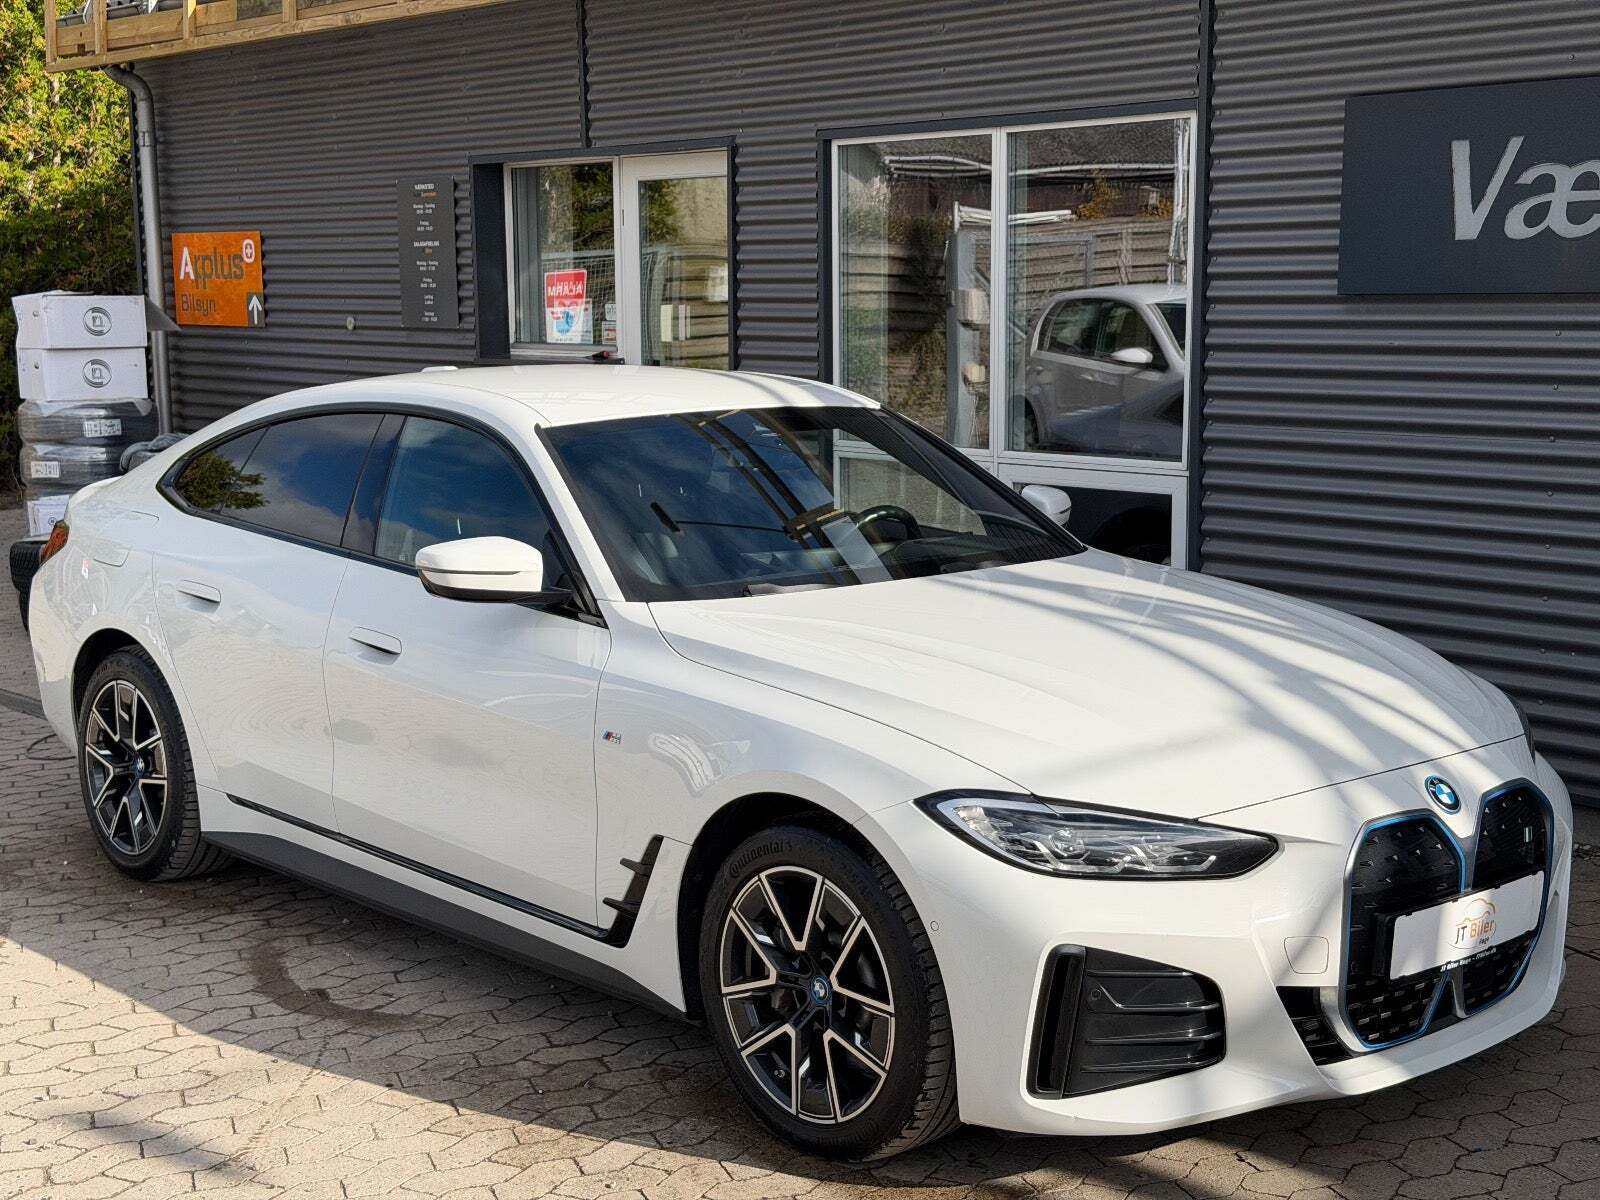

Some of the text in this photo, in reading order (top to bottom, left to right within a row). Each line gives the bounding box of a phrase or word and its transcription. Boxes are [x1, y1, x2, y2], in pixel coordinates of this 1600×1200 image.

[181, 294, 216, 316] Bilsyn
[1455, 920, 1495, 944] JT Biler
